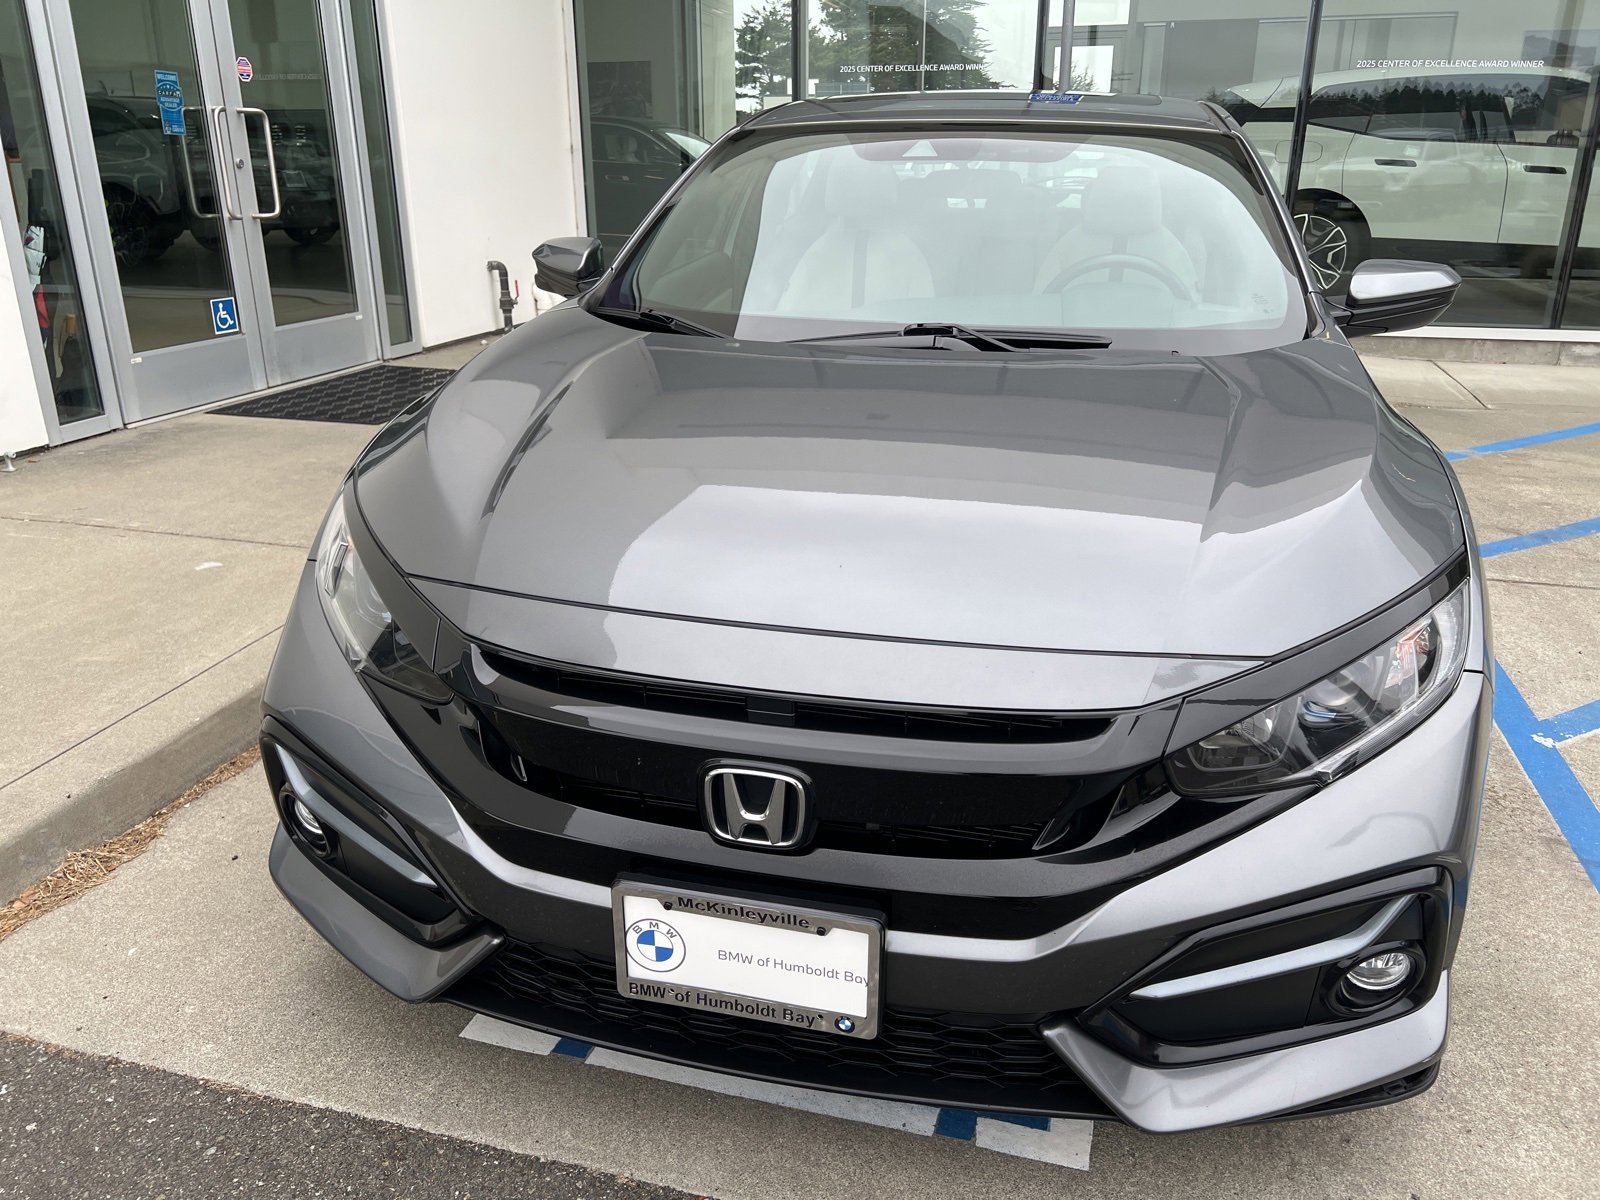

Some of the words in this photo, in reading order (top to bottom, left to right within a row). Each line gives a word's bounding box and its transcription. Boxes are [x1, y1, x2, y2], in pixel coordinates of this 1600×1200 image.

[840, 65, 856, 73] 2025
[856, 65, 884, 73] CENTER
[894, 64, 938, 72] EXCELLENCE
[939, 63, 965, 71] AWARD
[965, 63, 985, 71] WINN
[1356, 60, 1376, 68] 2025
[1377, 60, 1410, 68] CENTER
[1411, 60, 1423, 68] OF
[1424, 60, 1477, 68] EXCELLENCE
[1478, 60, 1510, 68] AWARD
[1510, 60, 1545, 68] WINNER
[677, 896, 810, 929] McKinleyville
[631, 921, 678, 940] BMW
[717, 949, 754, 965] BMW
[757, 953, 771, 967] of
[773, 954, 840, 980] Humboldt
[843, 970, 869, 988] Bay
[628, 982, 667, 999] BMW
[674, 989, 691, 1004] of
[696, 993, 777, 1019] Humboldt
[782, 1007, 815, 1029] Bay
